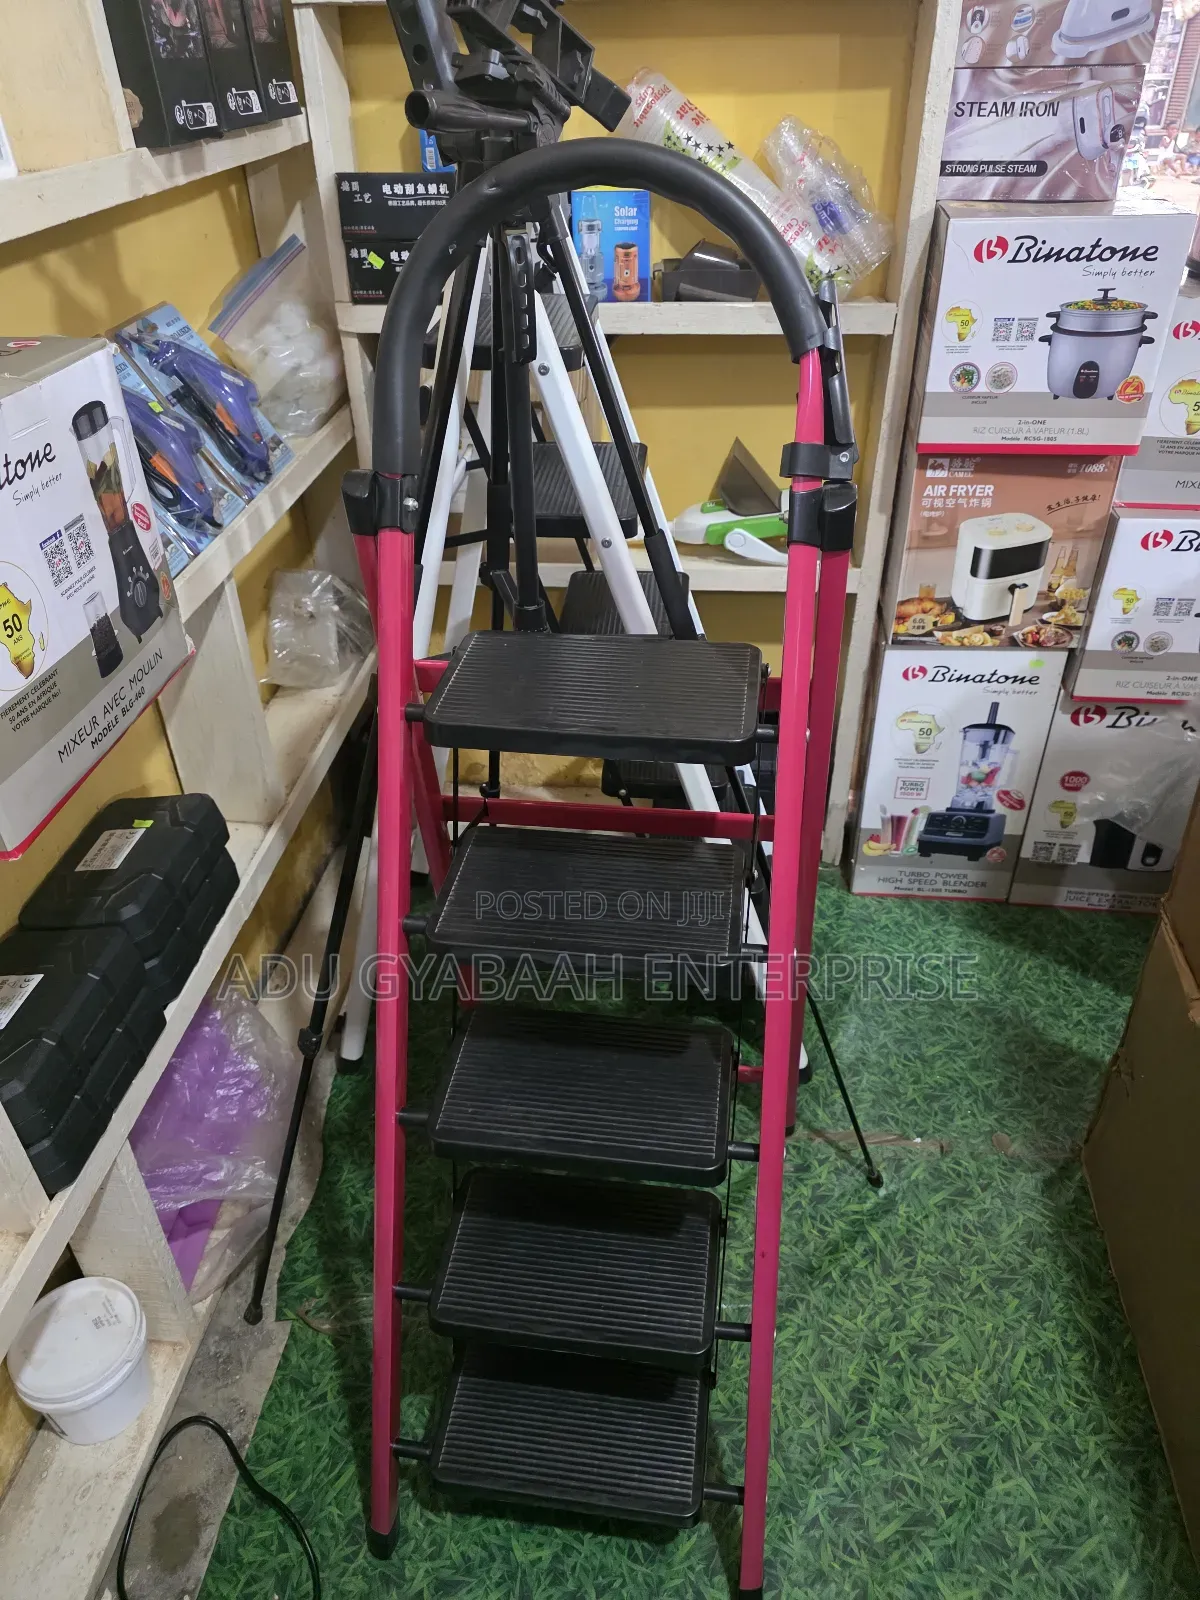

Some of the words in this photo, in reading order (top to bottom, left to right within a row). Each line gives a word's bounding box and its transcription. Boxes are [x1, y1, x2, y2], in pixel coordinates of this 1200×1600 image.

[635, 84, 655, 108] Cups
[633, 84, 672, 128] Disposable
[954, 101, 1015, 118] STEAM
[1018, 101, 1060, 117] IRON
[945, 164, 978, 174] STRONG
[979, 164, 1006, 174] PULSE
[1007, 164, 1037, 174] STEAM
[614, 206, 638, 217] Solar
[614, 218, 638, 226] Charging
[1007, 235, 1159, 264] Binatone
[1082, 265, 1116, 279] Simply
[1121, 267, 1155, 278] better
[988, 427, 1024, 435] CUISEUR
[13, 485, 41, 506] Simply
[41, 472, 62, 488] better
[923, 485, 947, 497] AIR
[949, 485, 995, 497] FRYER
[921, 498, 992, 508] 可视空气炸锅
[3, 613, 23, 639] 50
[13, 635, 24, 646] ANS
[928, 666, 1040, 685] Binatone
[982, 686, 1009, 696] Simply
[1011, 687, 1038, 695] better
[1133, 681, 1172, 690] CUISEUR
[0, 693, 31, 720] FIÈREMENT
[31, 668, 59, 696] CÉLÉBRANT
[8, 713, 16, 725] 50
[16, 704, 29, 720] ANS
[29, 698, 37, 710] EN
[36, 680, 58, 704] AFRIQUE
[58, 715, 100, 763] MIXEUR
[102, 686, 127, 720] AVEC
[129, 648, 163, 690] MOULIN
[12, 714, 31, 733] VOTRE
[30, 697, 52, 721] MARQUE
[91, 714, 120, 749] MODÈLE
[121, 686, 146, 717] BLG-460
[918, 728, 933, 736] 50
[1064, 776, 1087, 784] 1000
[898, 870, 931, 878] TURBO
[934, 872, 968, 880] POWER
[907, 878, 937, 886] SPEED
[942, 880, 988, 888] BLENDER
